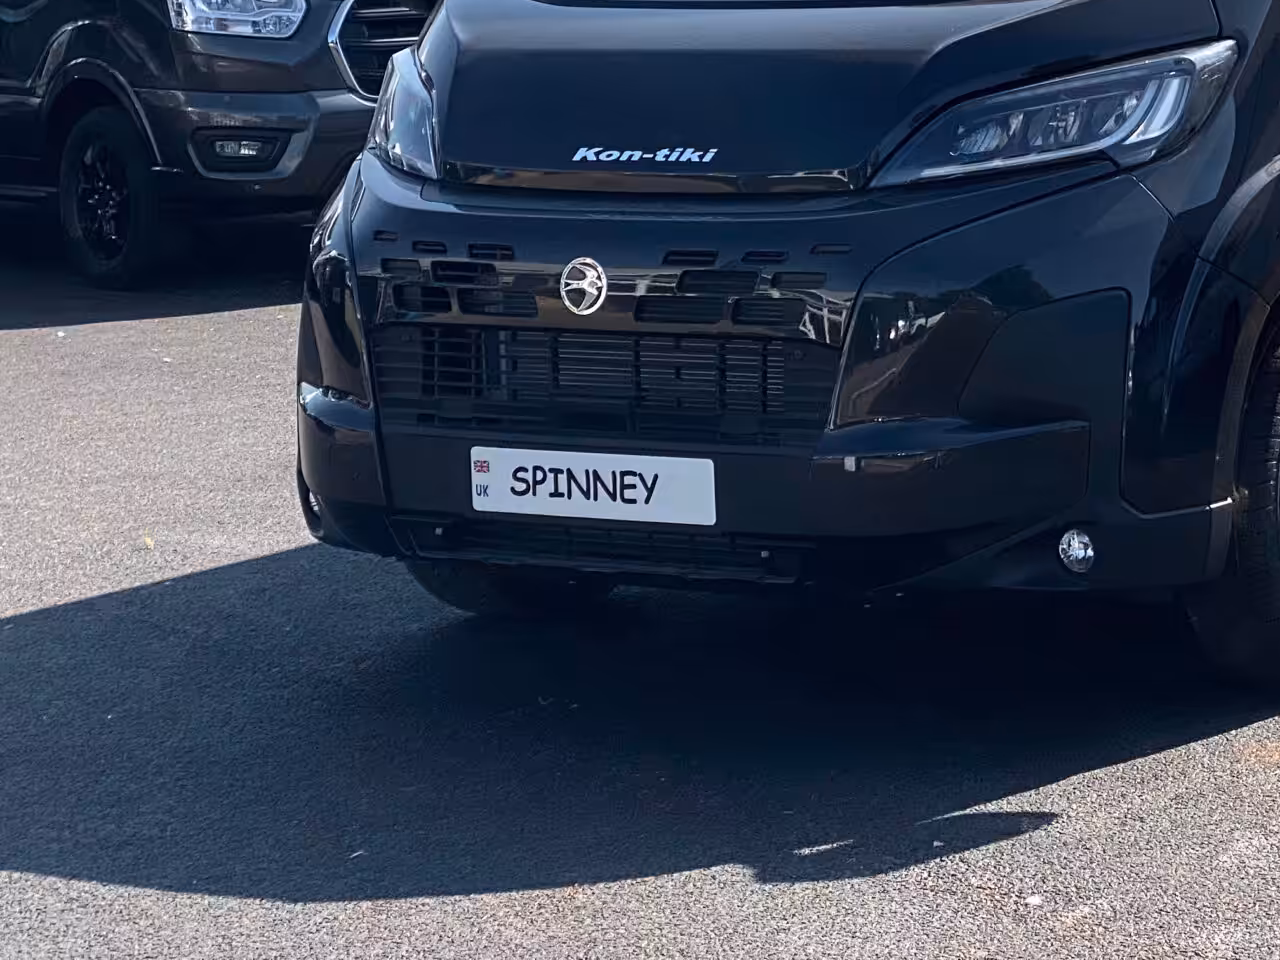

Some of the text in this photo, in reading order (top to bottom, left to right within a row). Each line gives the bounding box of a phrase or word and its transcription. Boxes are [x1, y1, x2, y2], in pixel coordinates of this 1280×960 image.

[572, 147, 719, 163] Kon-tiki
[475, 483, 489, 497] UK
[510, 465, 659, 505] SPINNEY
